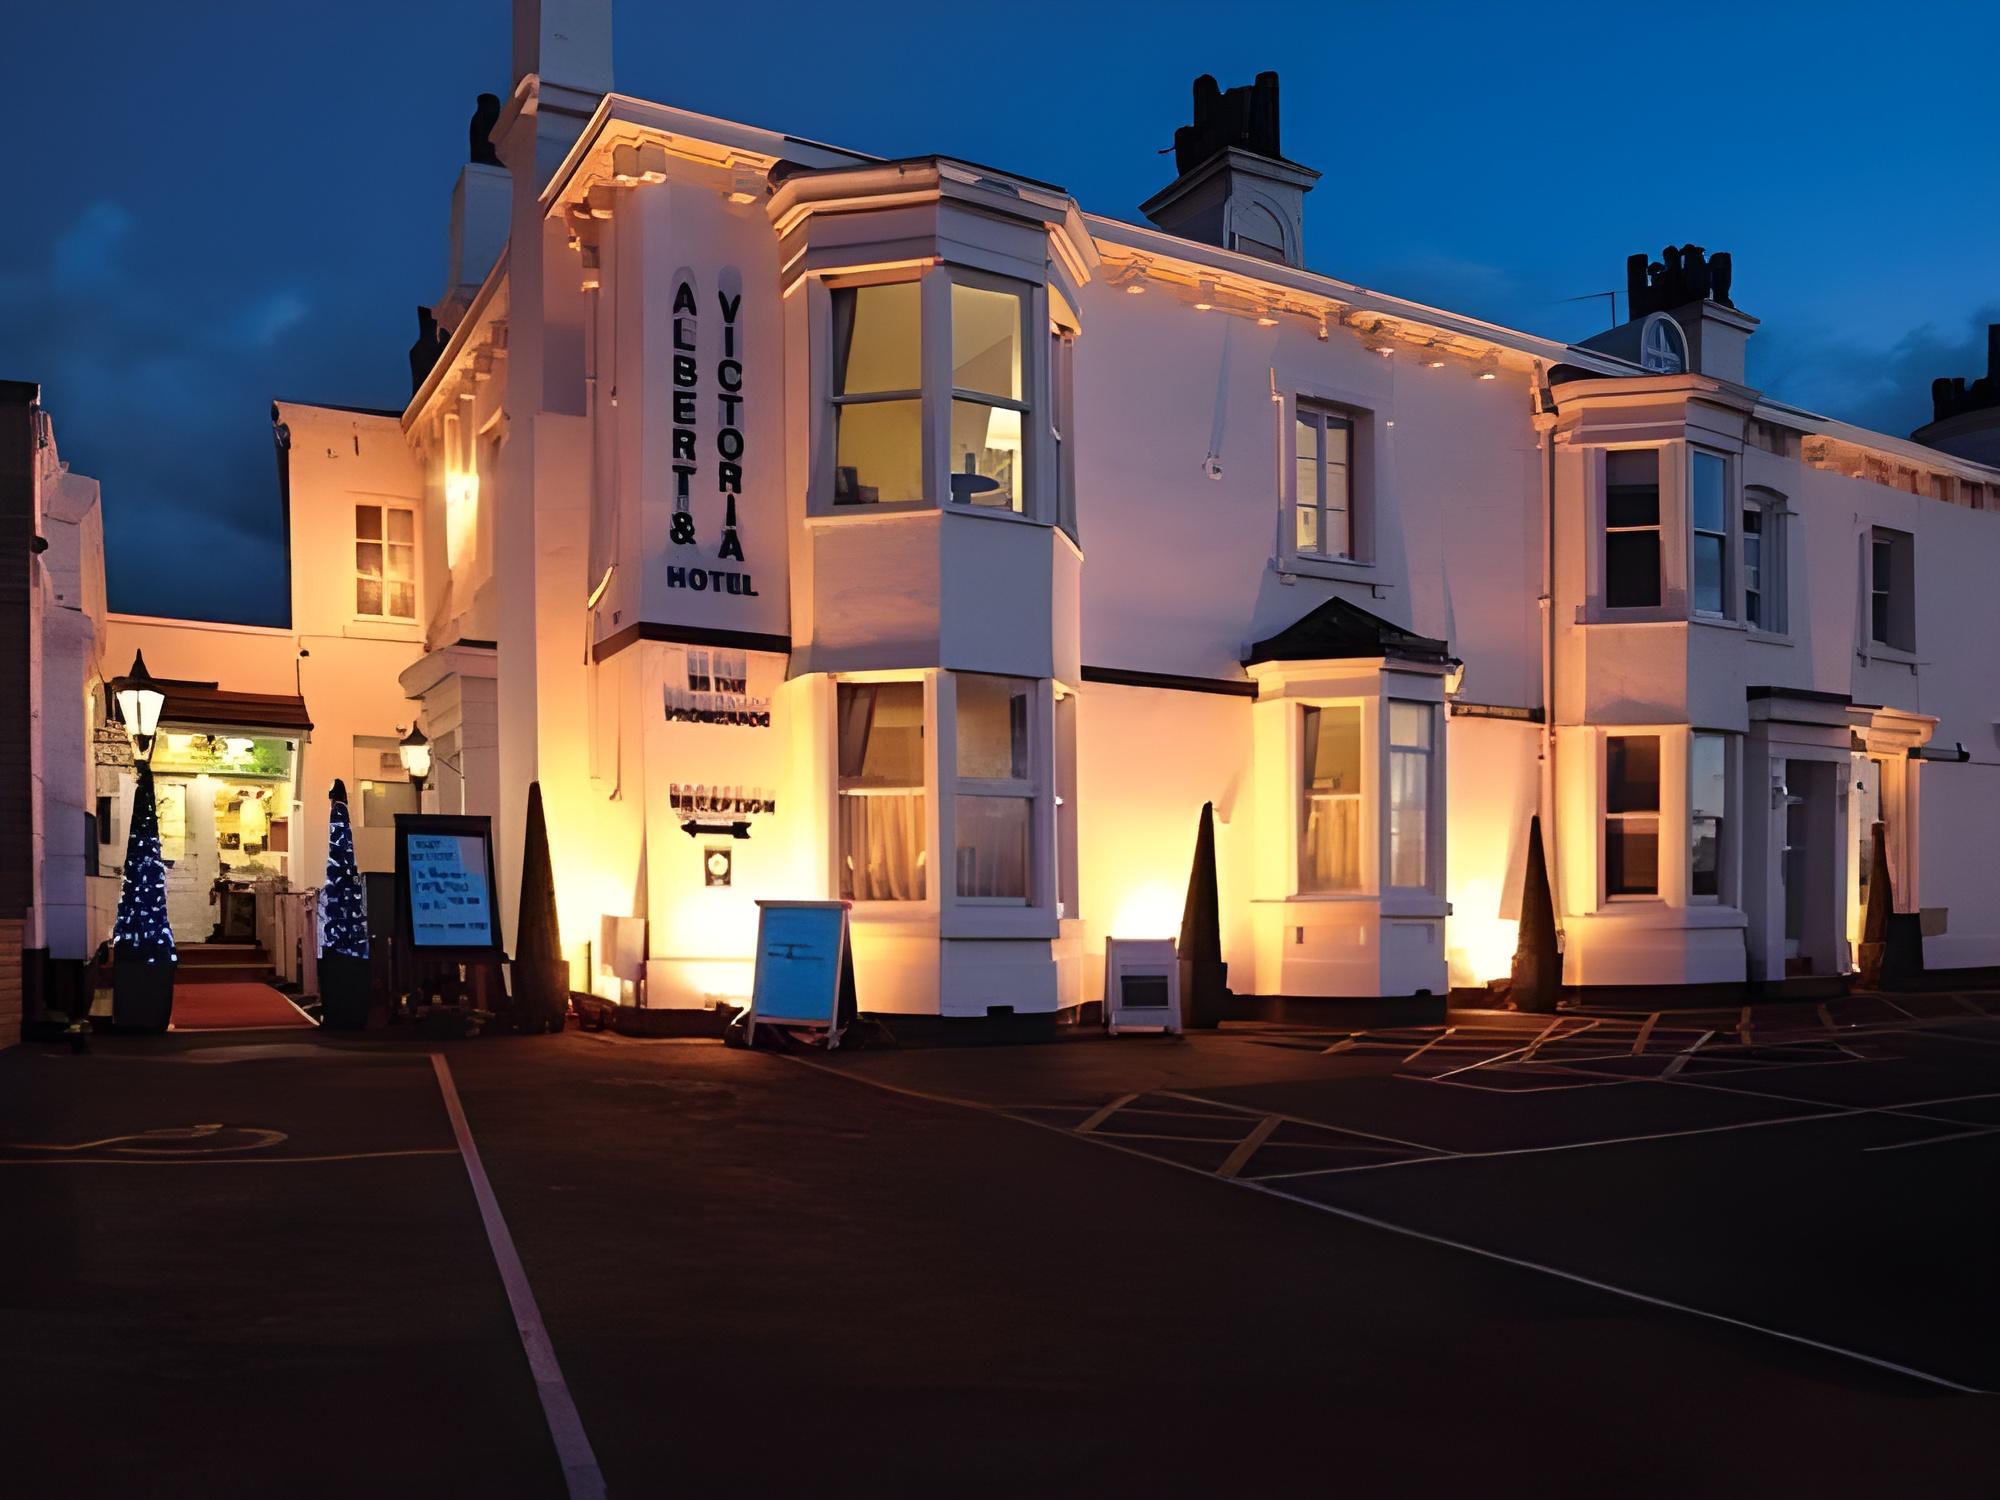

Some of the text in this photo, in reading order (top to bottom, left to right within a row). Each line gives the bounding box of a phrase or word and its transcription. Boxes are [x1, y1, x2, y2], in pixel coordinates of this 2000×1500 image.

[670, 282, 697, 544] ALBERT &
[717, 290, 744, 561] VICTORIA
